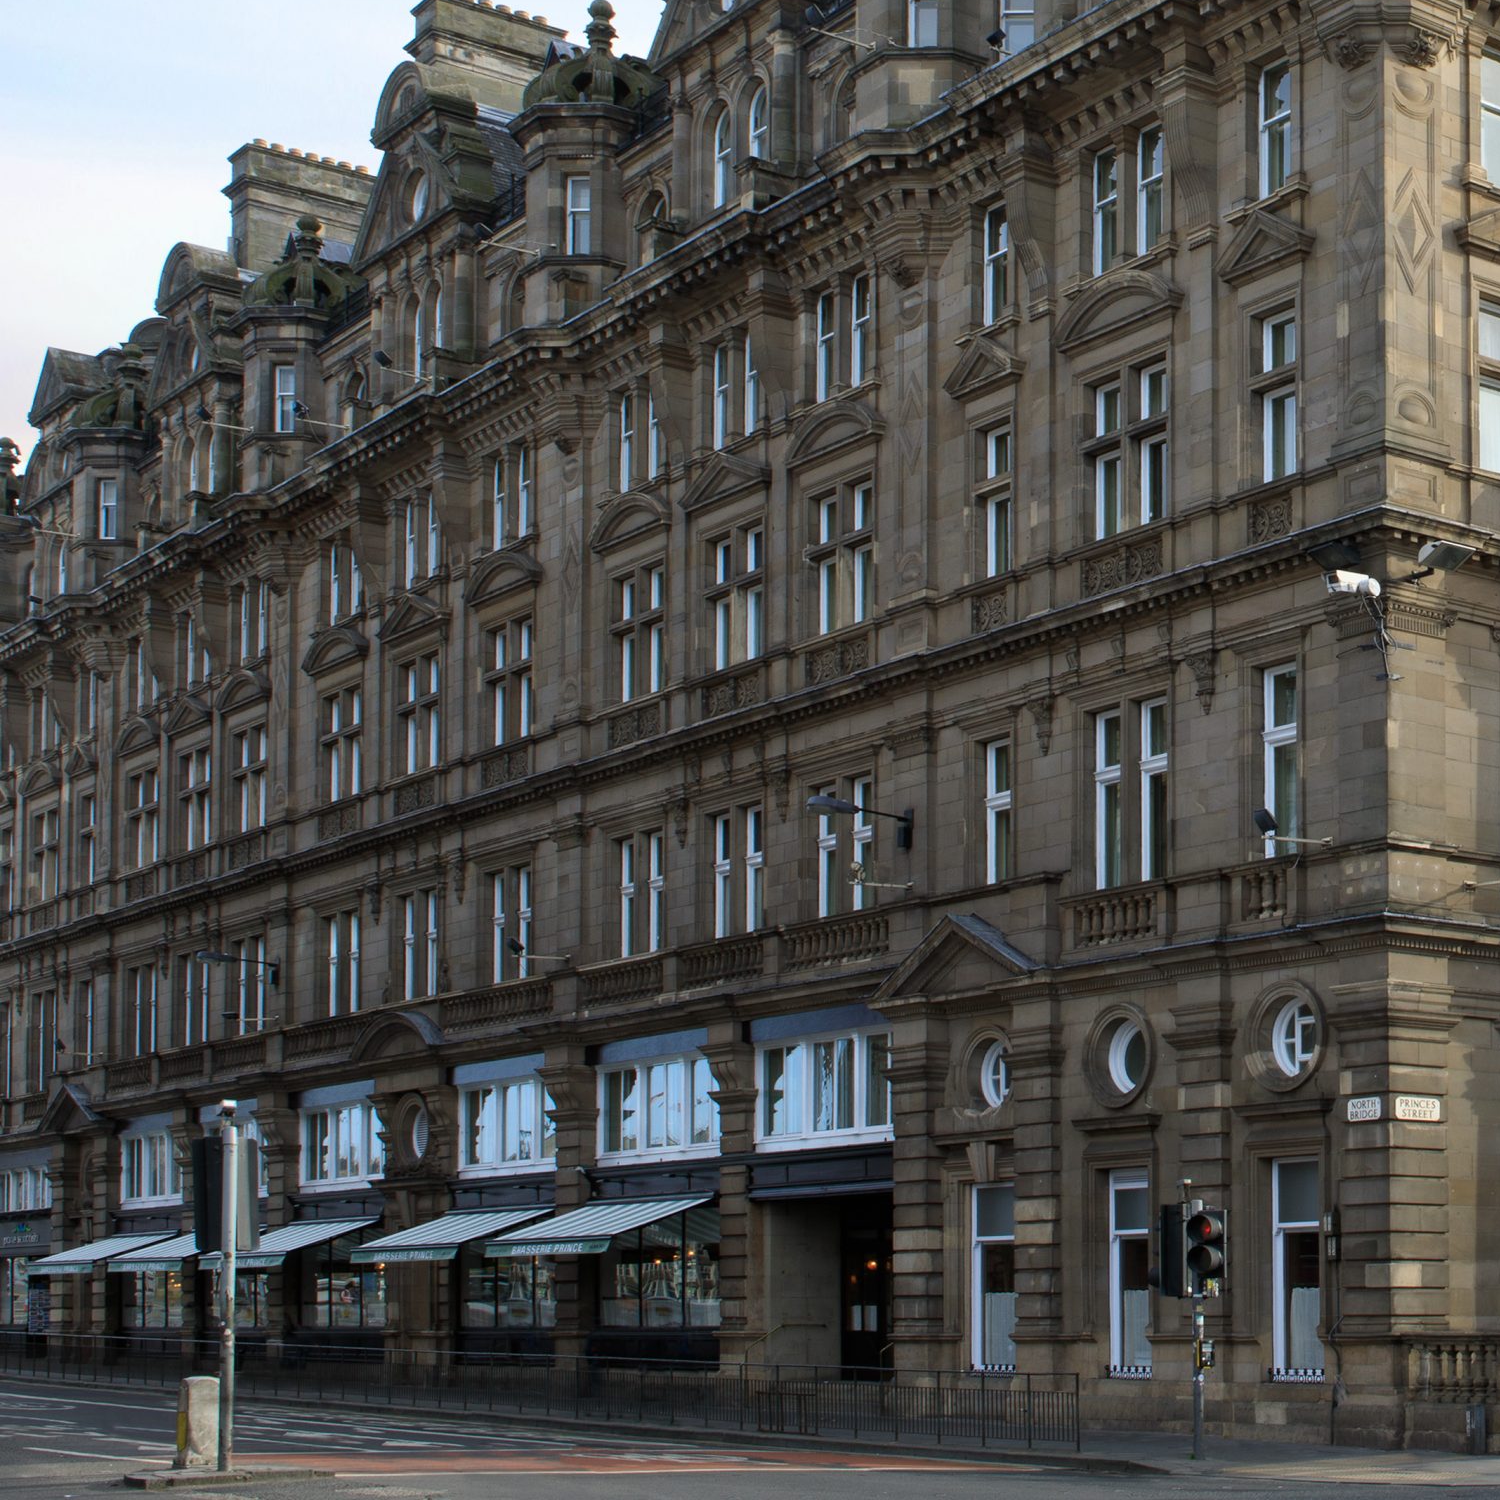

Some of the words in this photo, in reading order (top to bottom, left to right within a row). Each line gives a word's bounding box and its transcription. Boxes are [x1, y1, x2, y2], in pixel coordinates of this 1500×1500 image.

[1351, 1100, 1377, 1109] NORTH
[1400, 1099, 1436, 1109] PRINCES
[1349, 1109, 1377, 1119] BRIDGE
[1402, 1109, 1434, 1118] STREET
[511, 1244, 552, 1255] BRASSERIE
[553, 1242, 583, 1253] PRINCE
